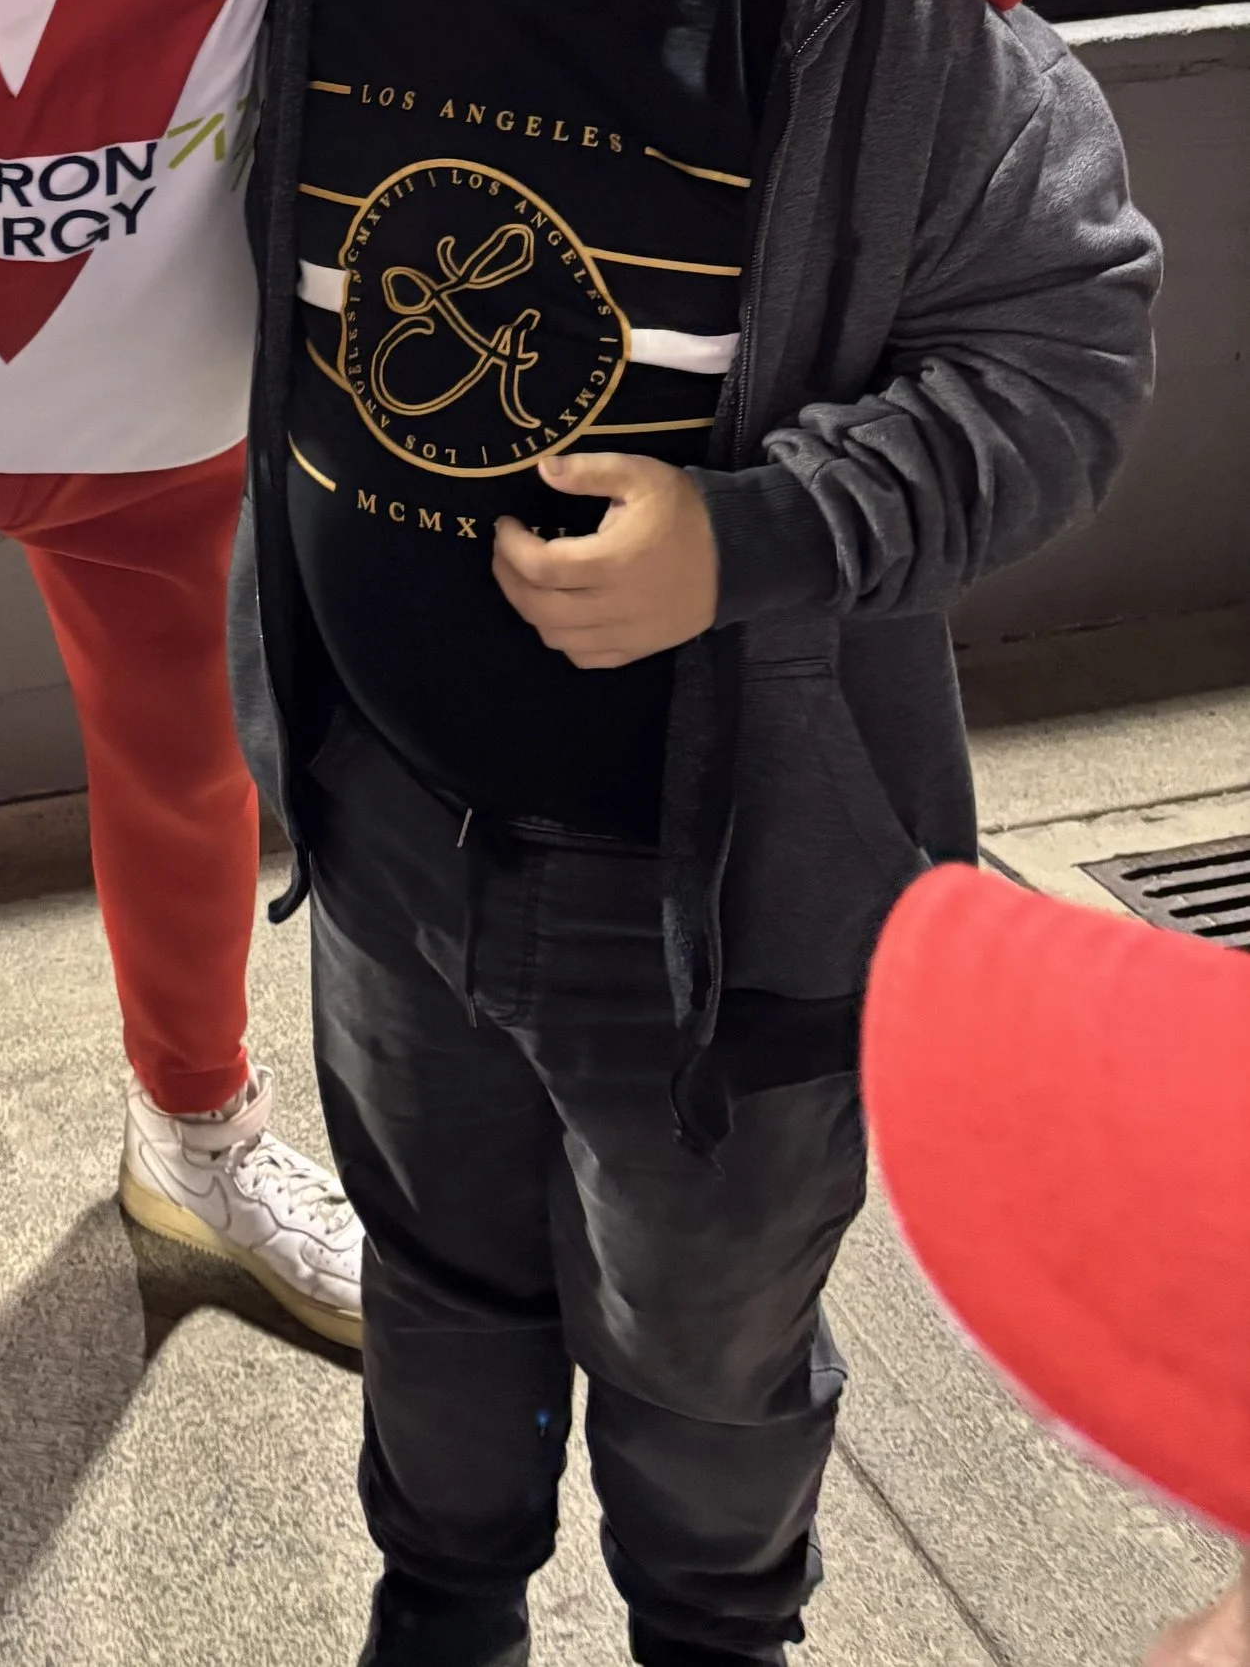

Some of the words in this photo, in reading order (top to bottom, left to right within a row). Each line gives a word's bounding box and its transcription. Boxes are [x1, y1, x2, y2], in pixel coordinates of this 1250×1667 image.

[361, 84, 416, 111] LOS
[439, 98, 623, 153] ANGELES
[451, 169, 500, 197] LOS
[514, 199, 612, 316] ANGELES
